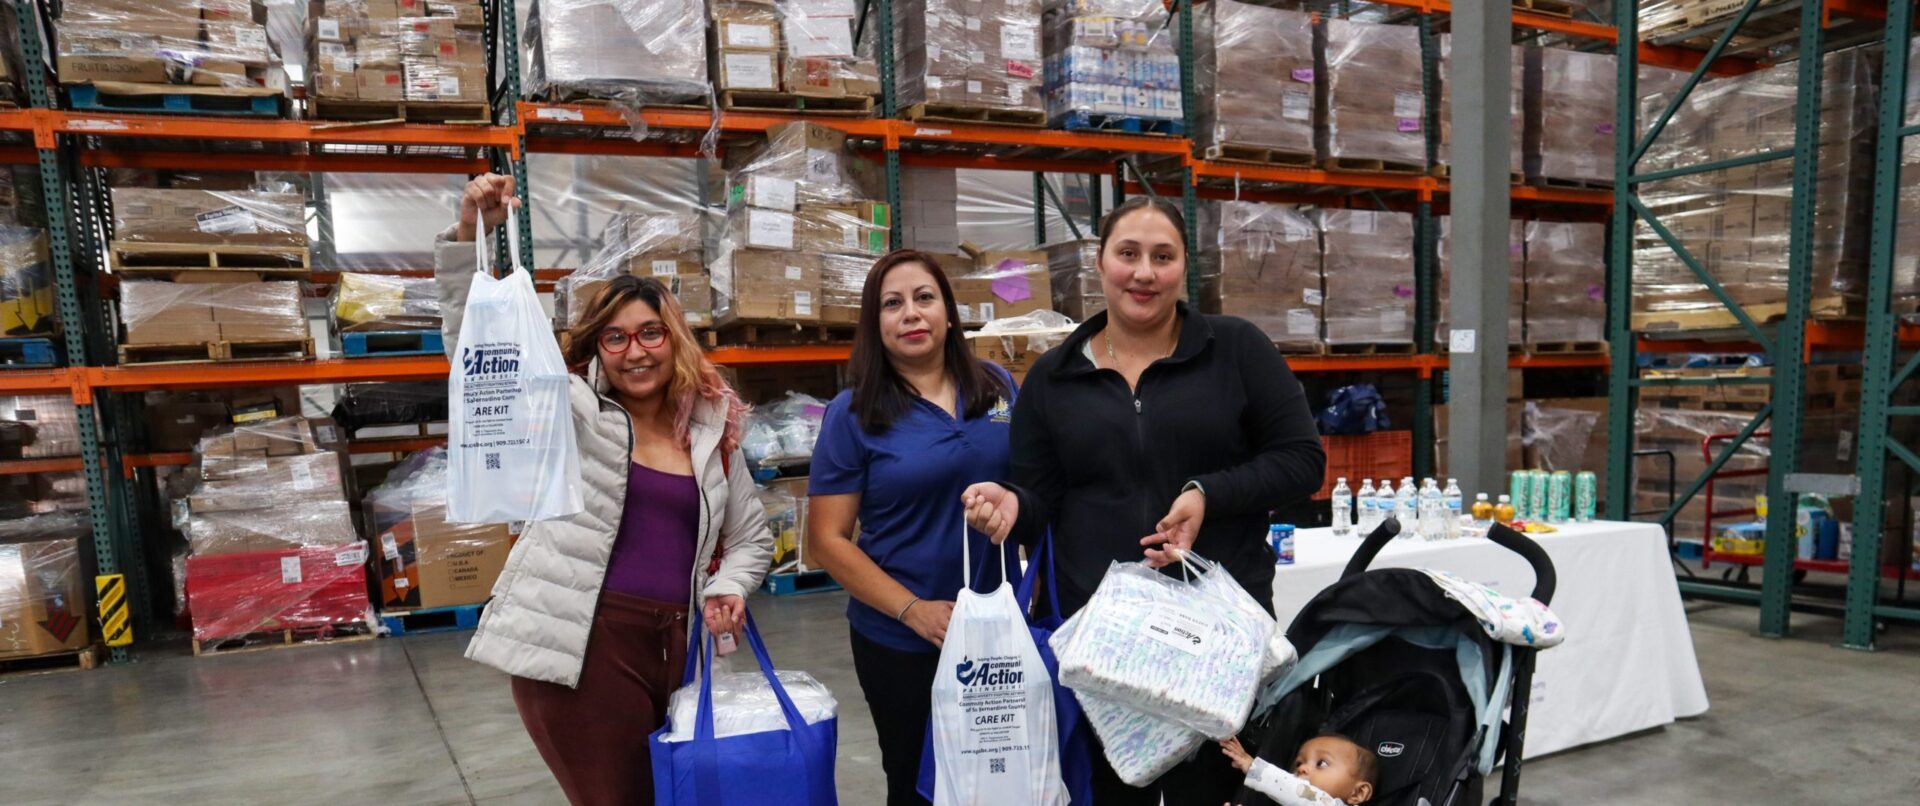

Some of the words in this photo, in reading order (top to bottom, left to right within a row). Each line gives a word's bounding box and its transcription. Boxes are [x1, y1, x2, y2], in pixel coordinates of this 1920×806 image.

[465, 350, 519, 375] Action
[472, 407, 492, 416] ARE
[494, 405, 509, 415] KIT
[990, 660, 1021, 669] communi
[975, 714, 999, 725] CARE
[1001, 713, 1015, 723] KIT
